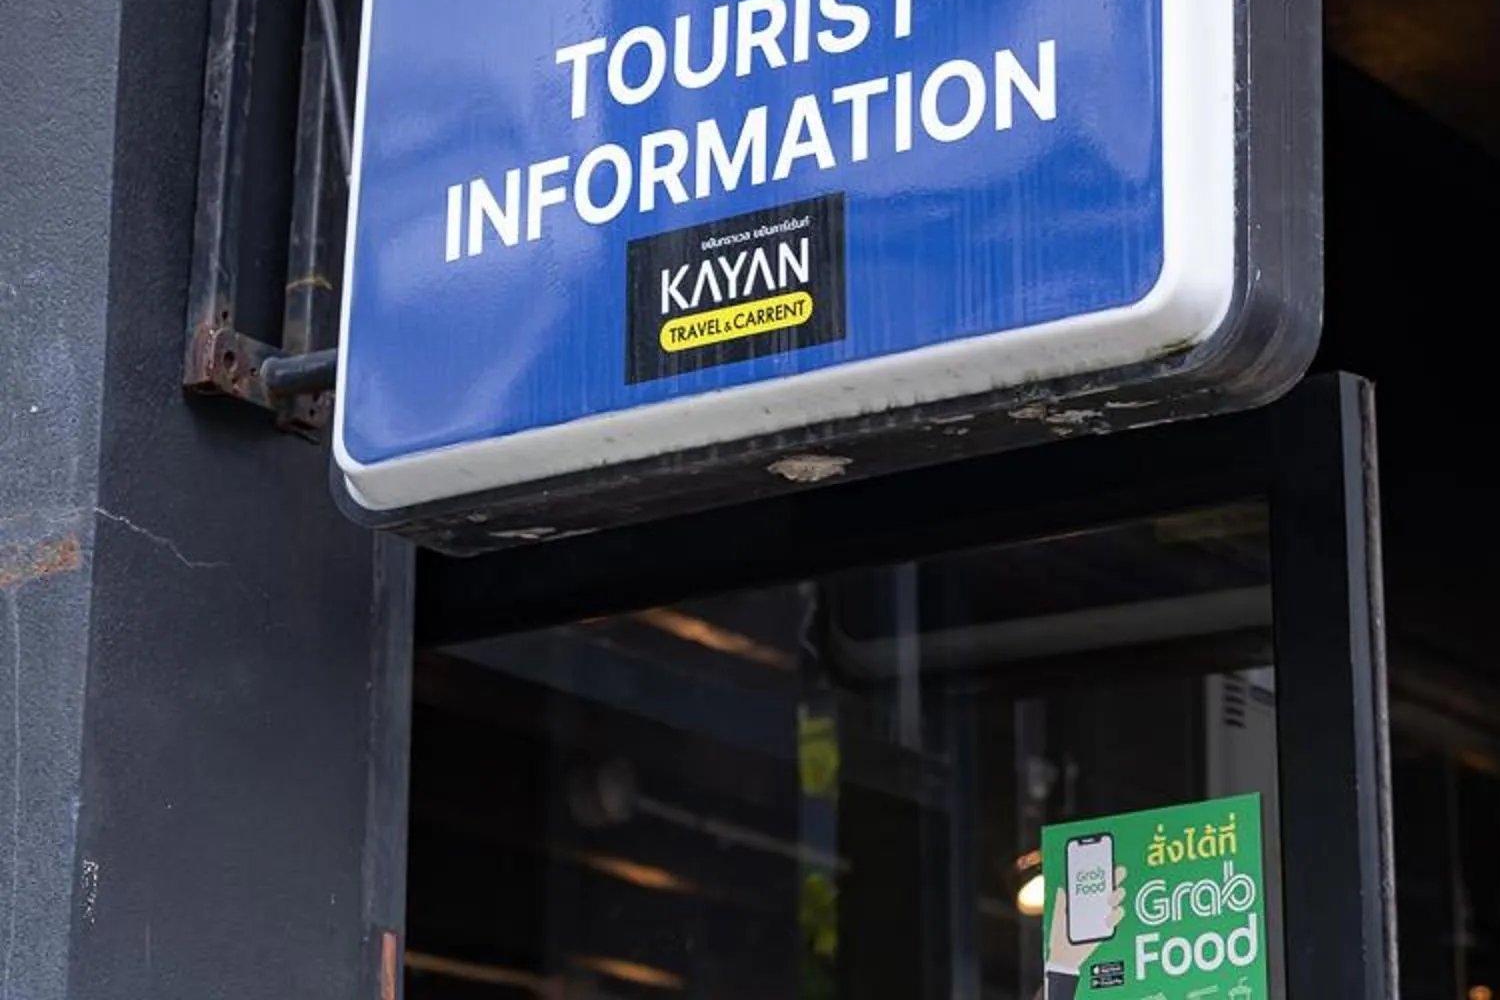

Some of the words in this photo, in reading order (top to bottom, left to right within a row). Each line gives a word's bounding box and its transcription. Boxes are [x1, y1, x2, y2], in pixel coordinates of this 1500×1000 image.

[445, 39, 1057, 263] INFORMATION
[661, 237, 809, 315] KAYAN
[669, 318, 722, 344] TRAVEL
[723, 321, 732, 333] &
[732, 299, 806, 329] CARRENT
[1146, 812, 1237, 867] สั่งได้ที่
[1135, 860, 1256, 926] Grab
[1135, 912, 1258, 981] Food
